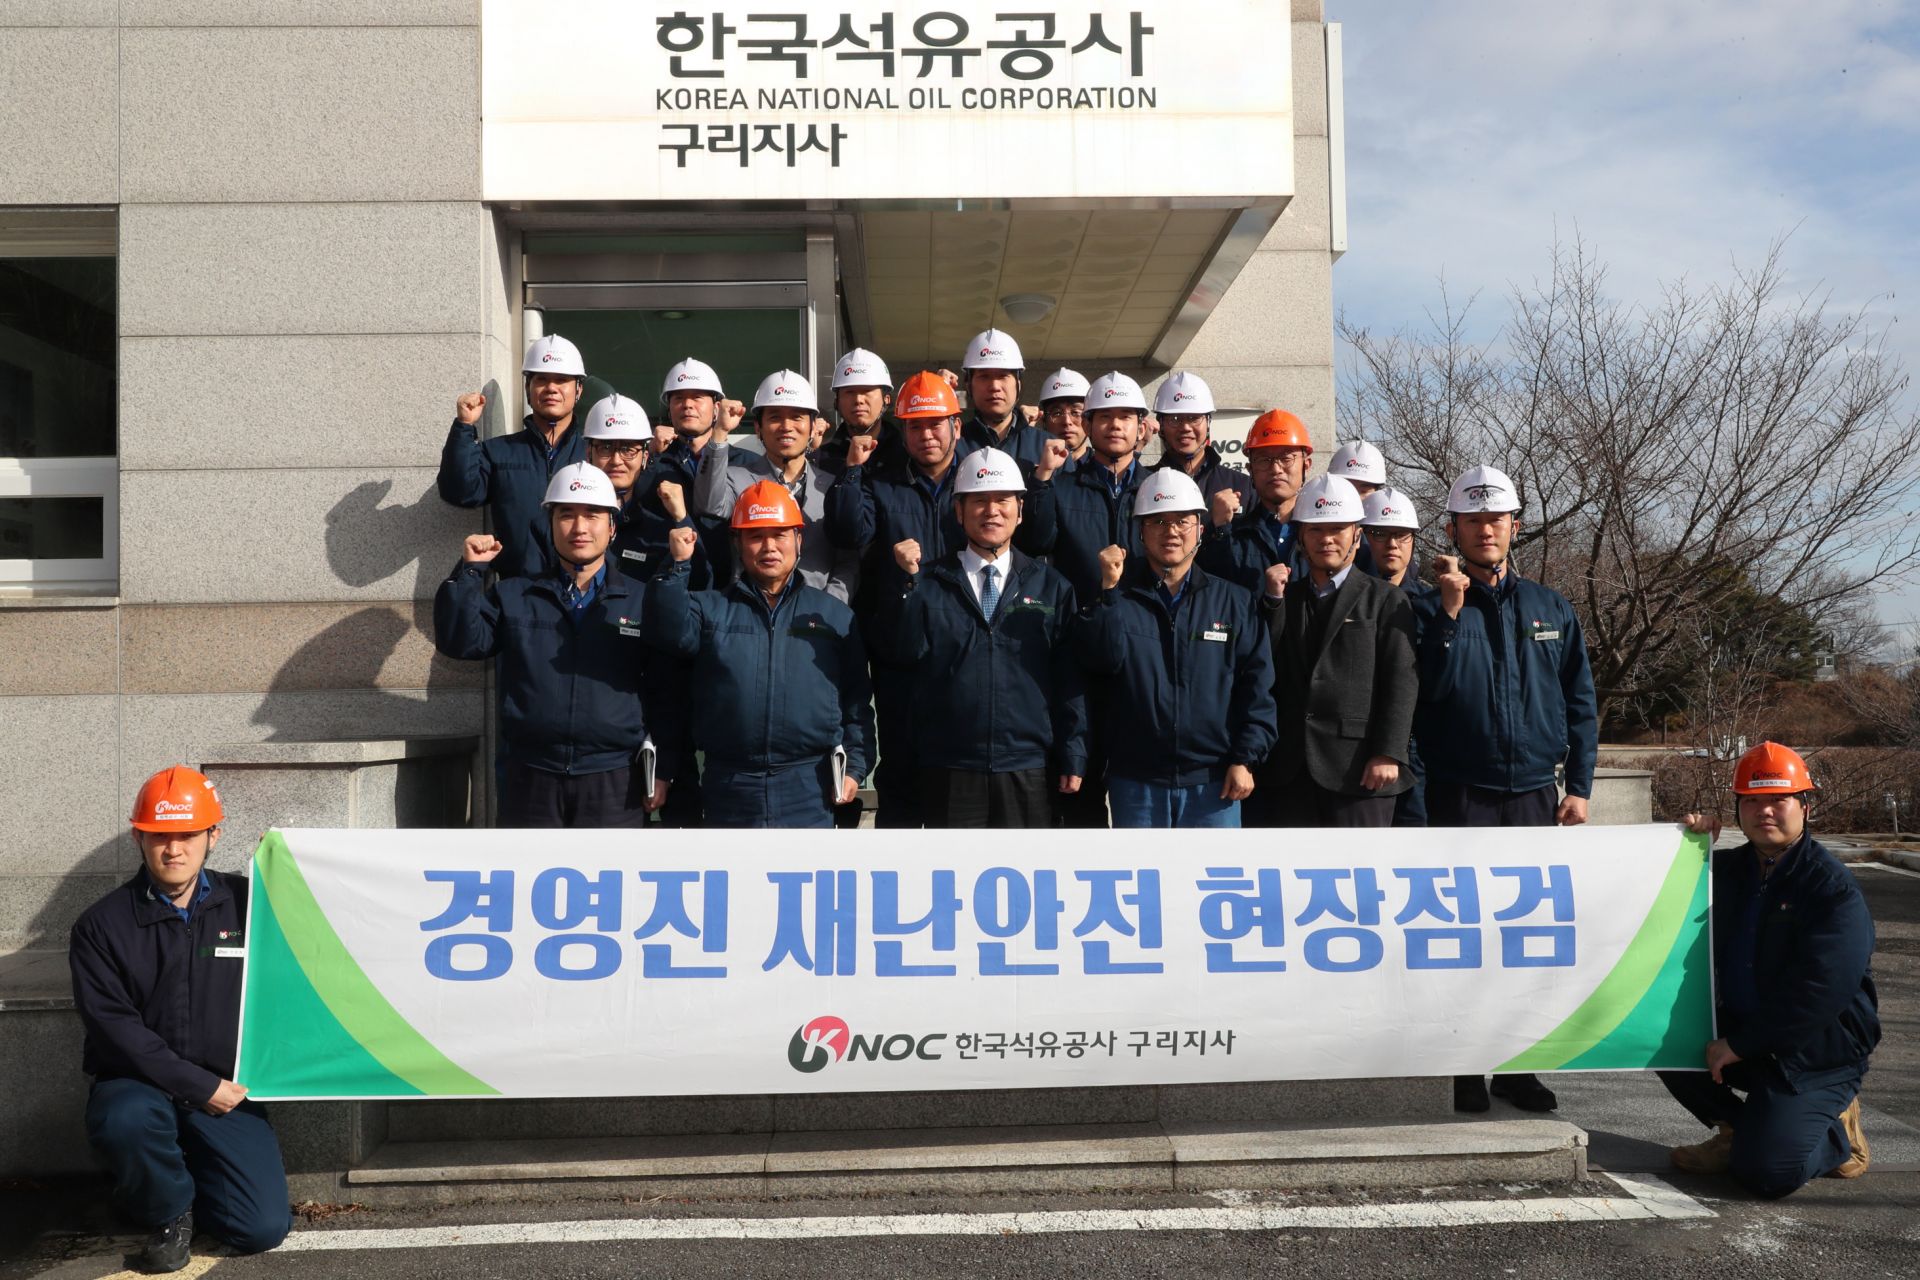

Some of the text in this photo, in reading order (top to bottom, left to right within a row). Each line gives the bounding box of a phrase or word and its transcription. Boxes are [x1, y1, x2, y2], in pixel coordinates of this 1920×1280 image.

[656, 11, 1154, 80] 한국석유공사
[656, 86, 1156, 111] KOREA NATIONAL OIL CORPORATION
[658, 123, 848, 167] 구리지사
[155, 801, 193, 814] KNOC
[419, 865, 1576, 981] 경영진 재난안전 현장점검
[787, 1015, 1237, 1074] KNOC 한국석유공사 구리지사
